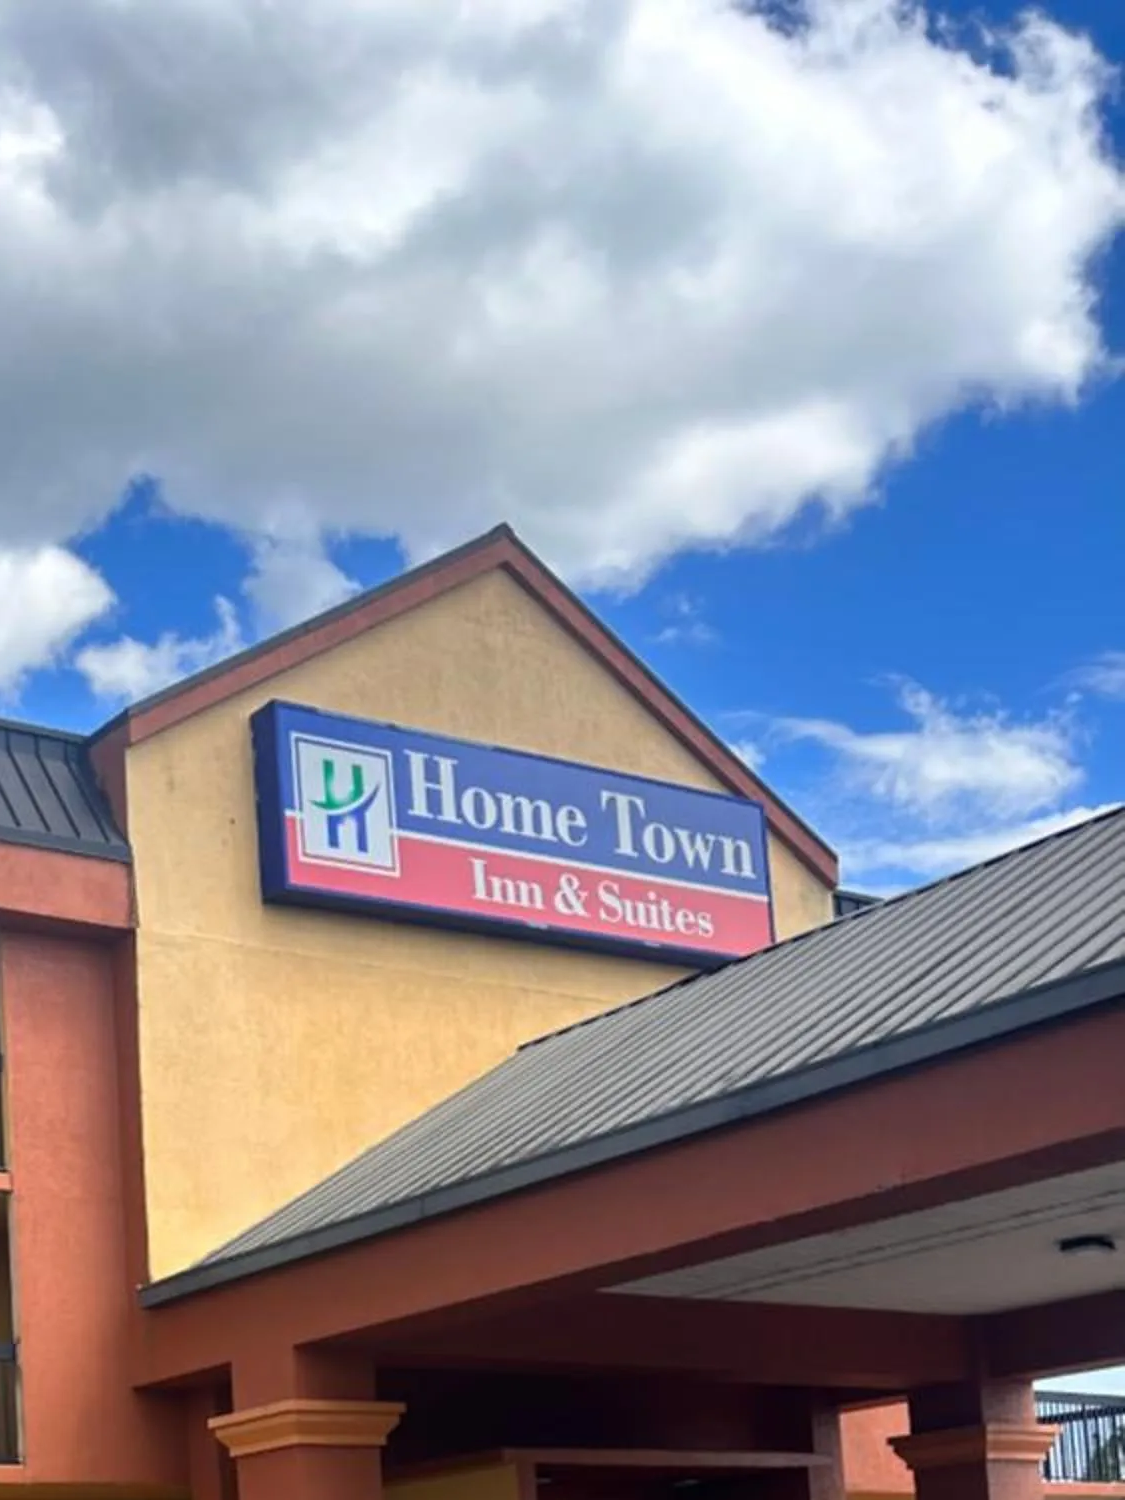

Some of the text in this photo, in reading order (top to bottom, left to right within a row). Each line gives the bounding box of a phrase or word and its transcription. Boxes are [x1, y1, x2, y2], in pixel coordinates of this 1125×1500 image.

[405, 750, 755, 877] Home Town
[469, 858, 714, 937] Inn & Suites
